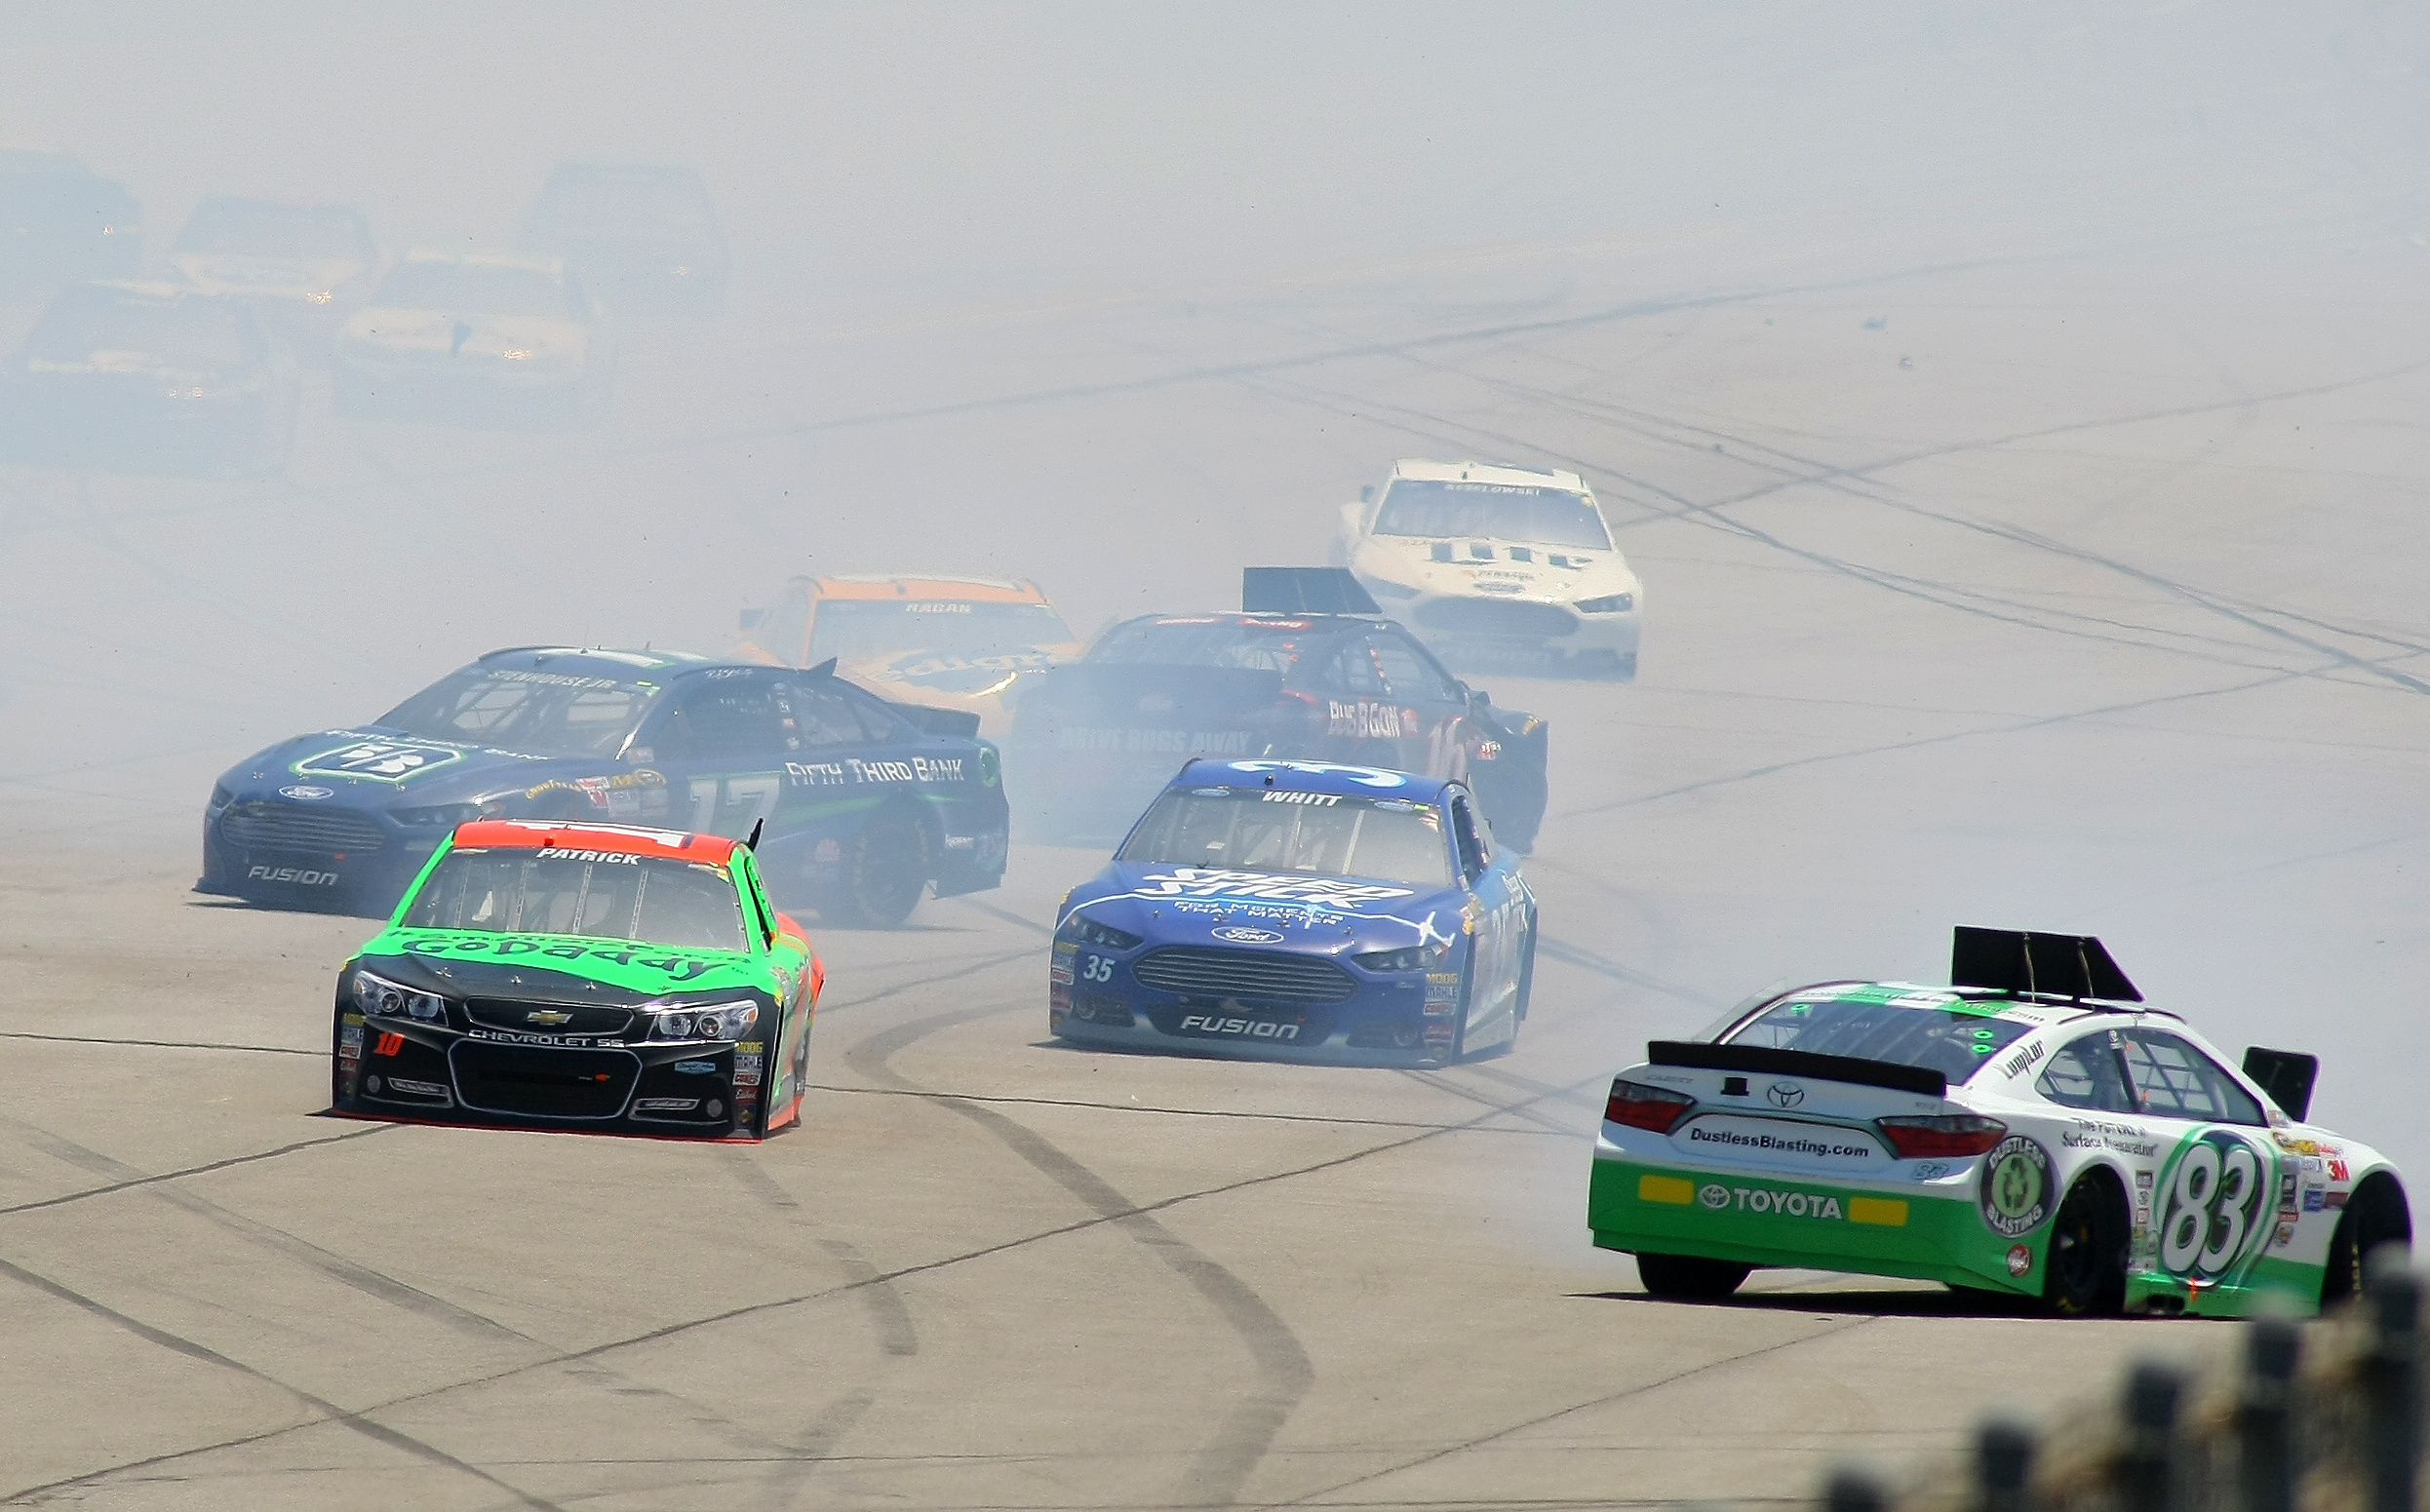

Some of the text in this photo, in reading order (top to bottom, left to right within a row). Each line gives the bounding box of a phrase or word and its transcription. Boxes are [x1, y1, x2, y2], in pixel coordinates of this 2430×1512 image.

[784, 756, 966, 787] FIFTH THIRD BANK
[1262, 791, 1344, 807] WHITT
[536, 847, 643, 866] PATRICK
[248, 865, 339, 886] FUSION
[402, 939, 730, 982] GoDaddy
[1083, 954, 1116, 983] 35
[468, 1028, 591, 1047] CHEVROLET
[1180, 1015, 1301, 1039] FUSION
[373, 1032, 406, 1057] 10
[1691, 1128, 1870, 1157] DustlessBlasting.com
[1989, 1136, 2046, 1170] DUSTLESS
[1734, 1187, 1843, 1220] TOYOTA
[2162, 1143, 2258, 1273] 83
